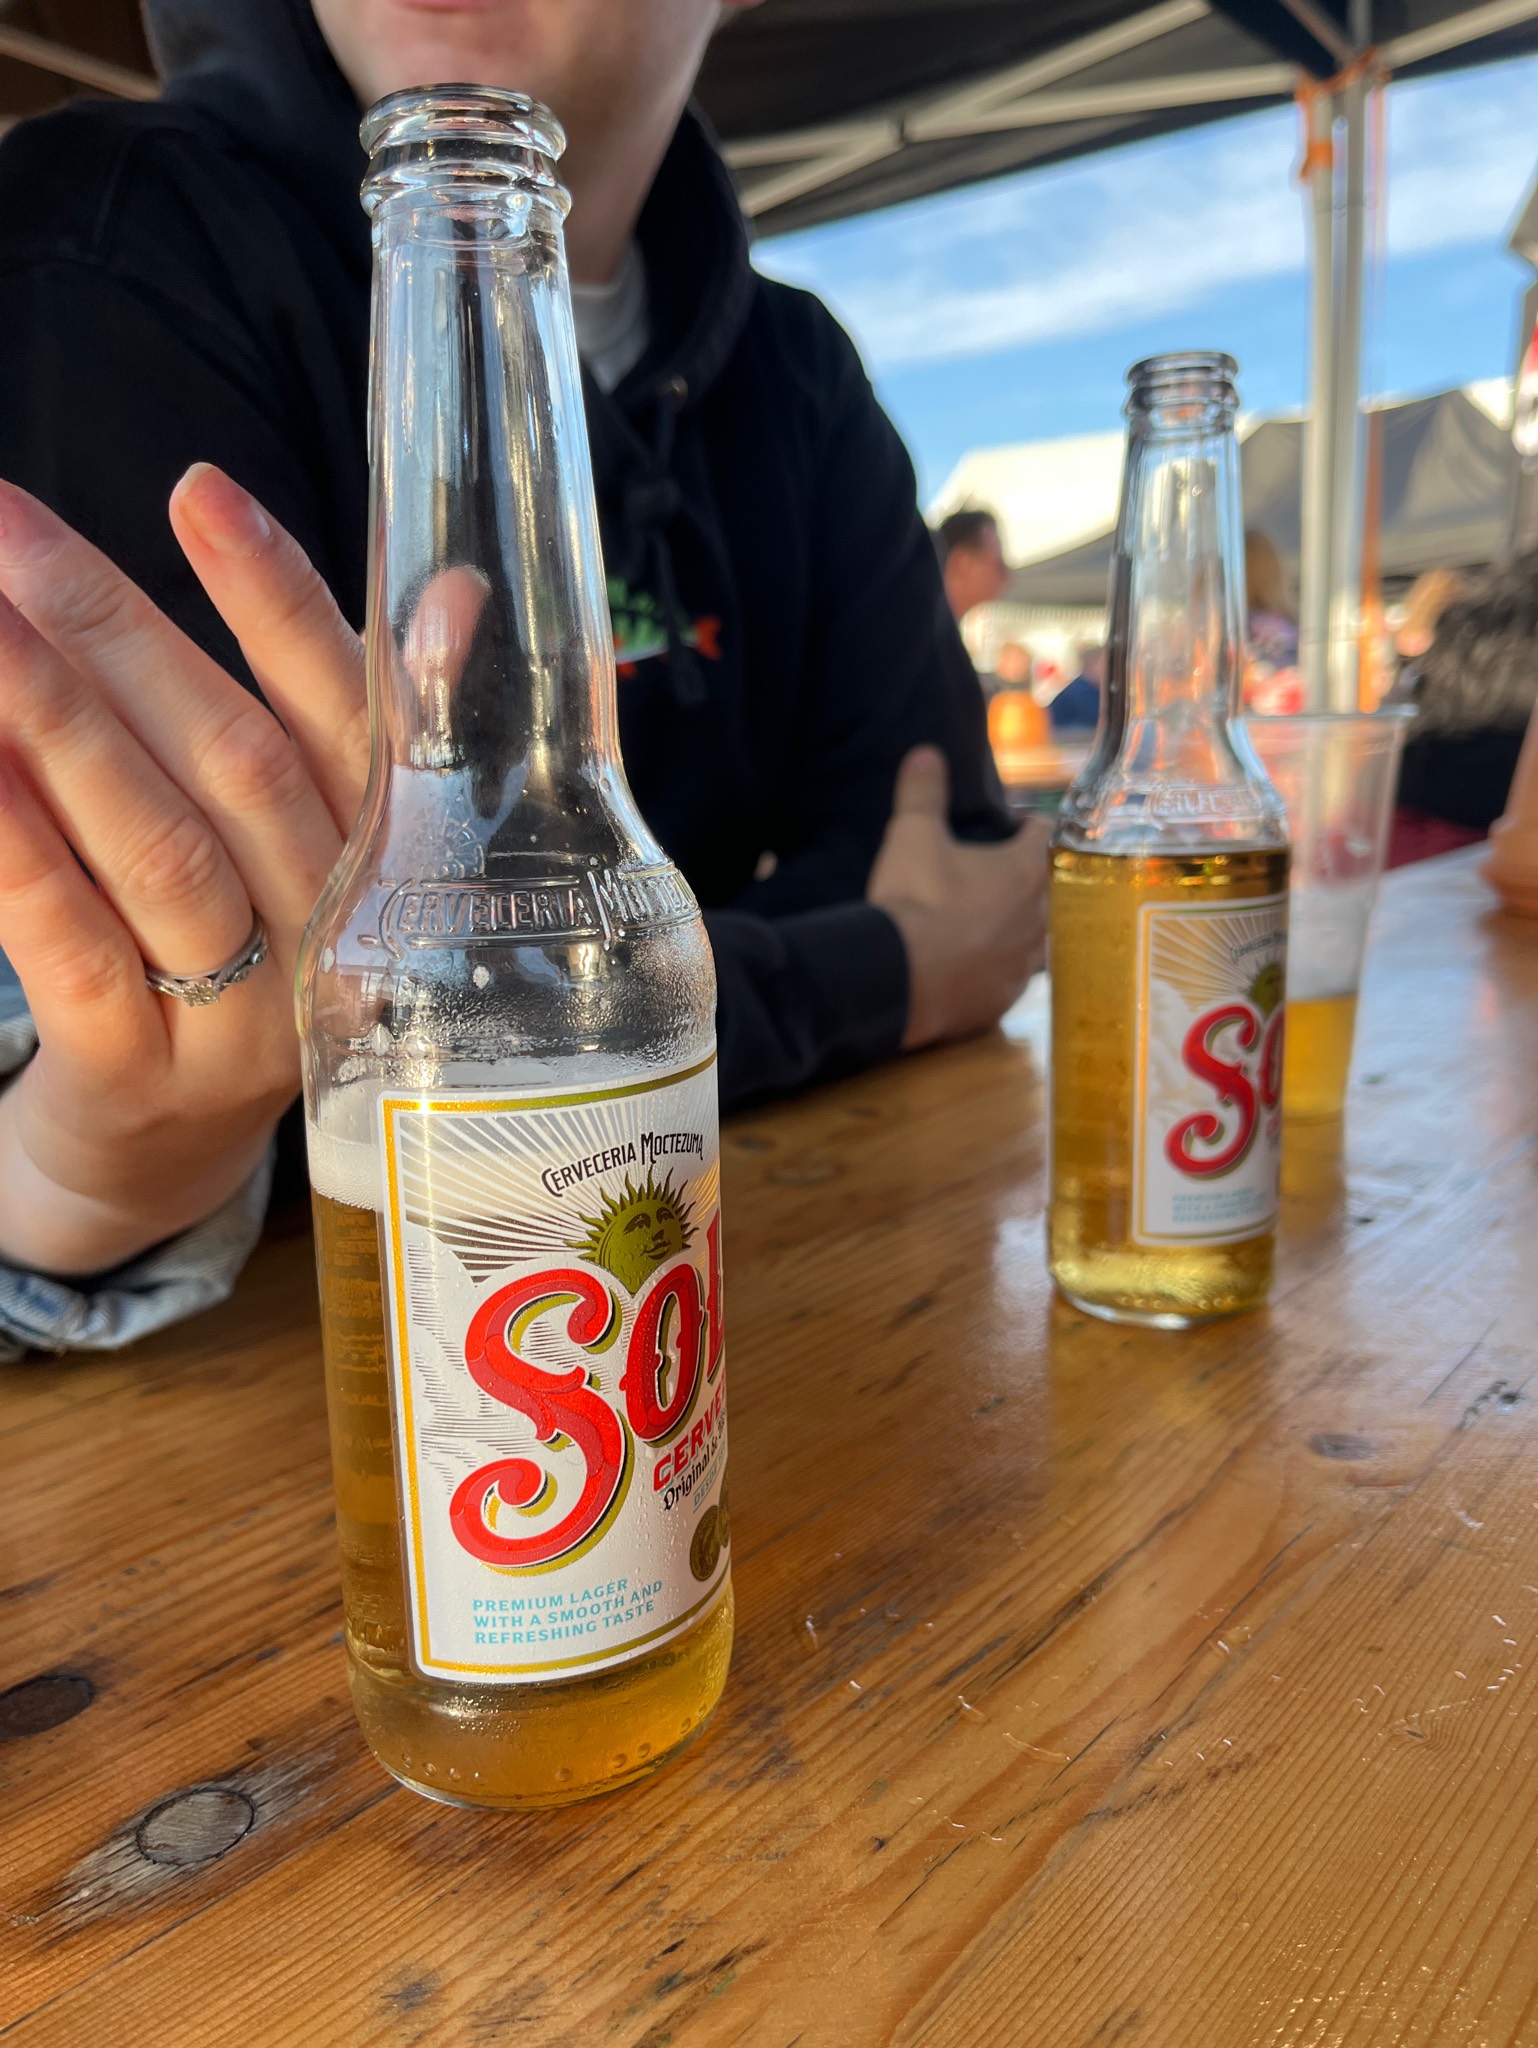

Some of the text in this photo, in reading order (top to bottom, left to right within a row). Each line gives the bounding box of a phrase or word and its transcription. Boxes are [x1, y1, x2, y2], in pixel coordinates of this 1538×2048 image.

[379, 876, 597, 962] CERVECERIA
[541, 1132, 703, 1197] CERVECERIA MOCTEZUMA
[663, 1451, 710, 1511] Original
[473, 1579, 628, 1612] PREMIUM LAGER
[474, 1580, 662, 1628] WITH A SMOOTH AND
[475, 1601, 655, 1644] REFRESHING TASTE
